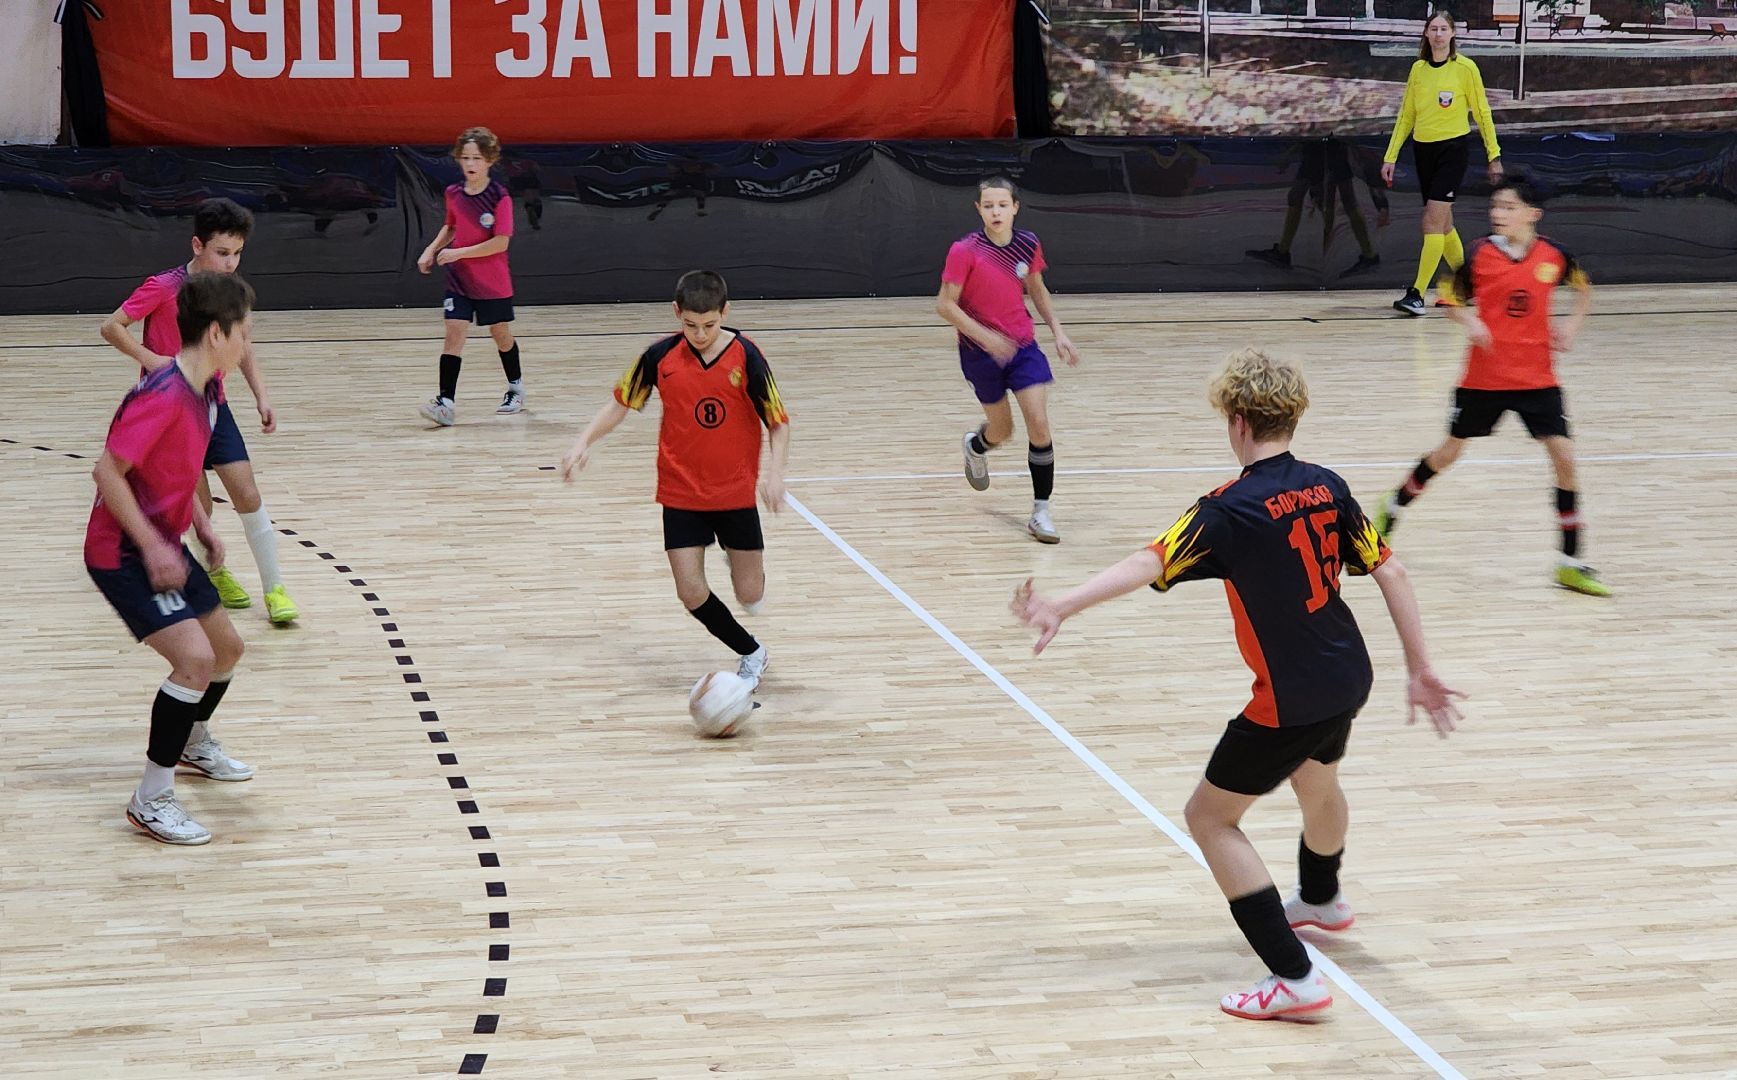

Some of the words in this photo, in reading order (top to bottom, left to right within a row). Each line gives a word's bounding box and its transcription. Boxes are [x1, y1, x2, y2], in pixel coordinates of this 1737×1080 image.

[495, 0, 612, 78] ЗА
[637, 0, 917, 78] НАМИ!
[703, 403, 718, 424] 8
[1264, 484, 1334, 520] БОРИСОВ
[1288, 509, 1341, 613] 15
[152, 590, 187, 616] 10
